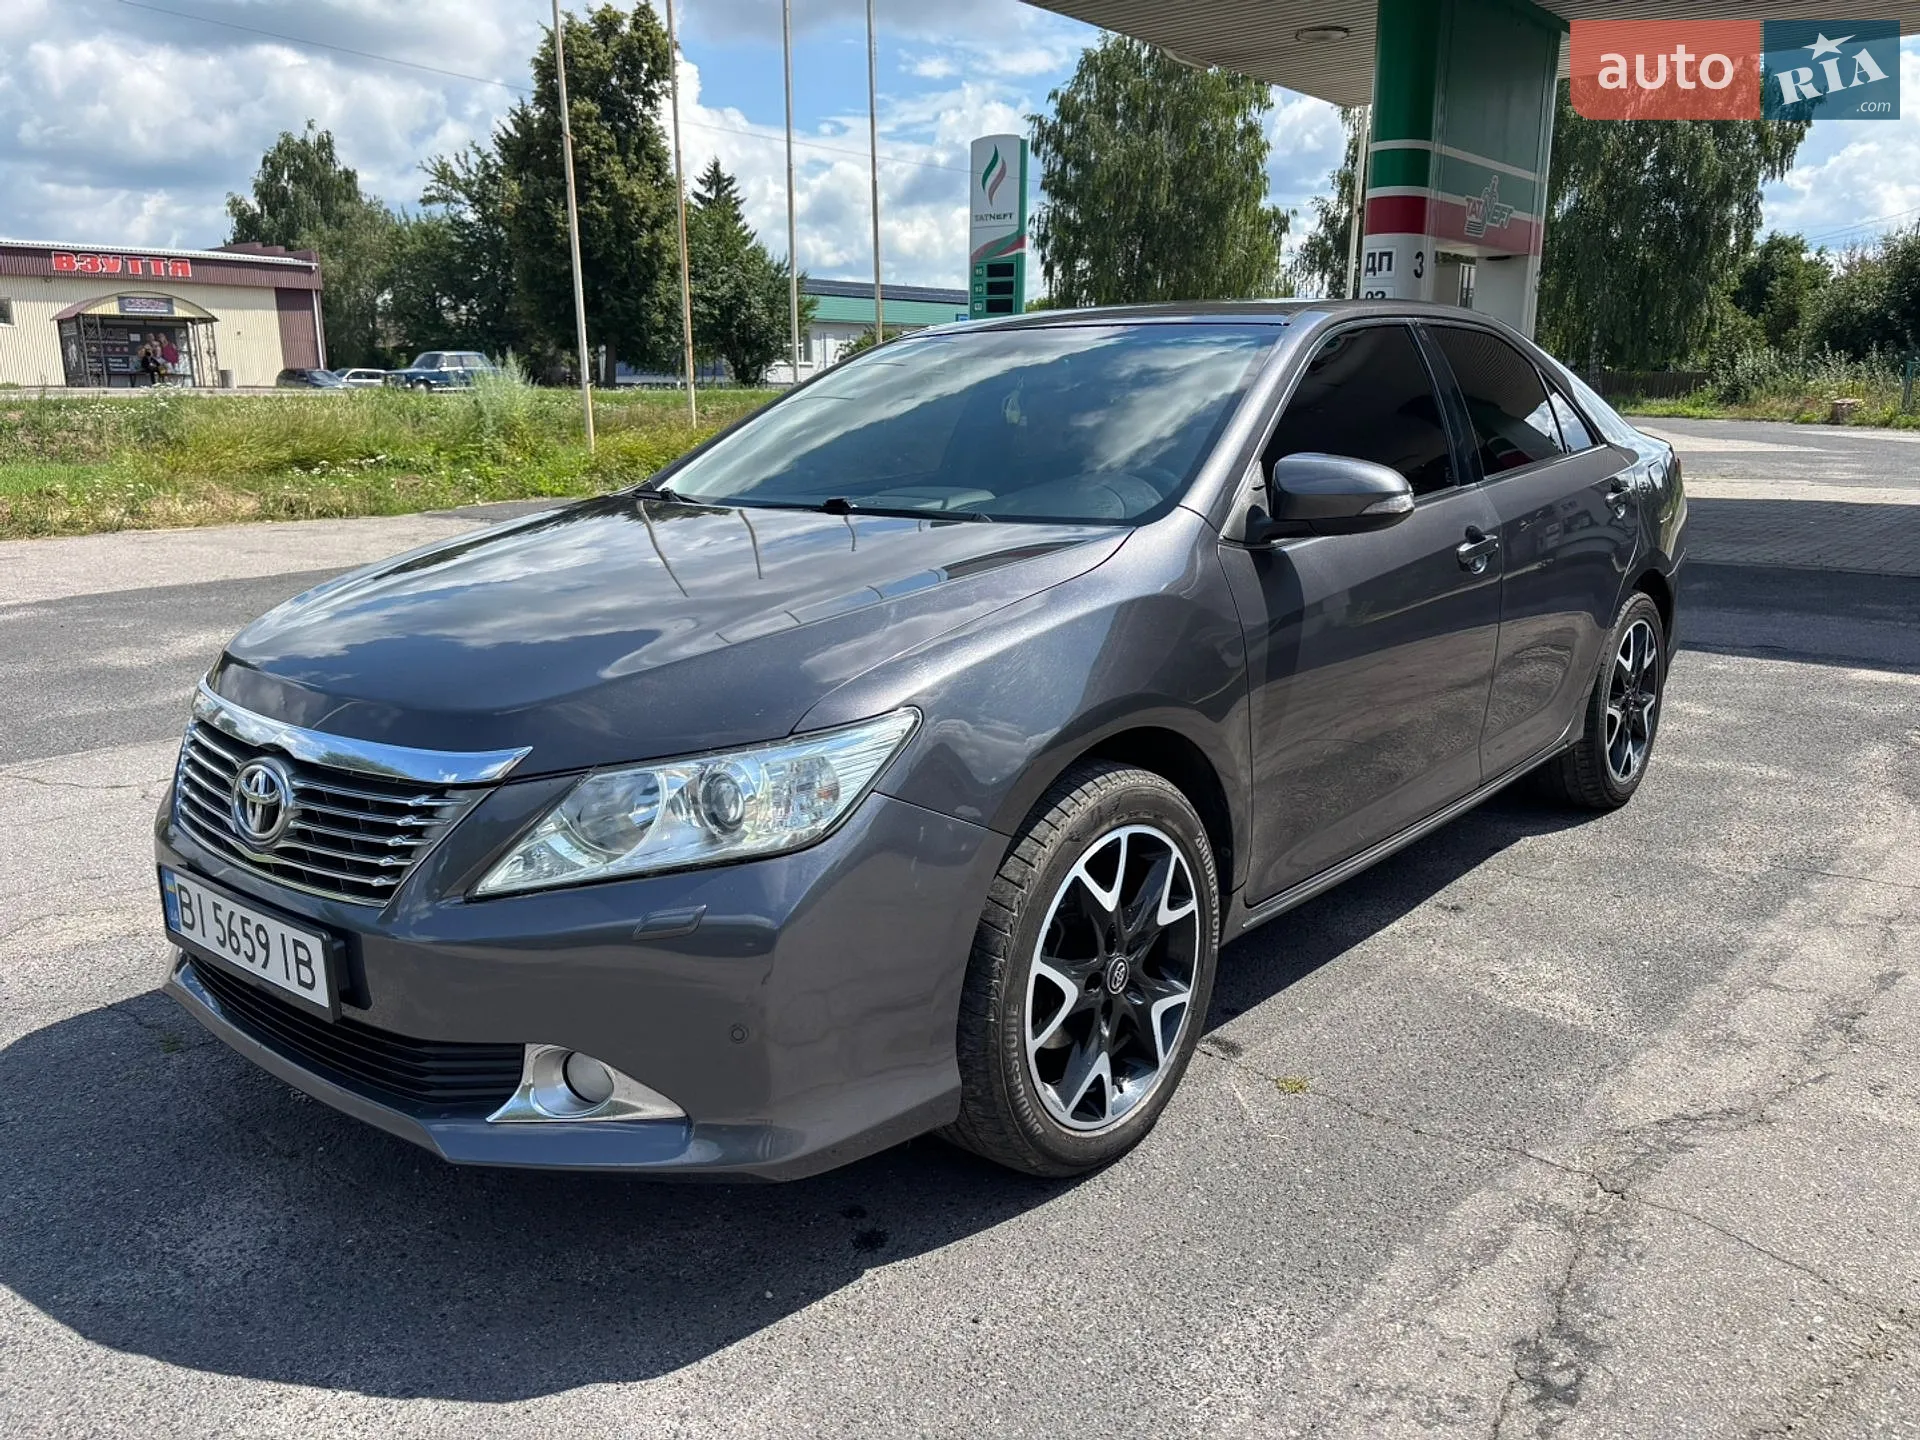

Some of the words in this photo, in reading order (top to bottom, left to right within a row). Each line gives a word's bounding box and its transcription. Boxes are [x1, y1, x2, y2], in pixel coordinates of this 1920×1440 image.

[51, 250, 193, 278] ВЗУТТЯ
[1365, 251, 1393, 277] ДП
[1413, 251, 1424, 279] 3
[177, 883, 206, 938] BI
[212, 901, 271, 970] 5659
[281, 932, 316, 991] IB
